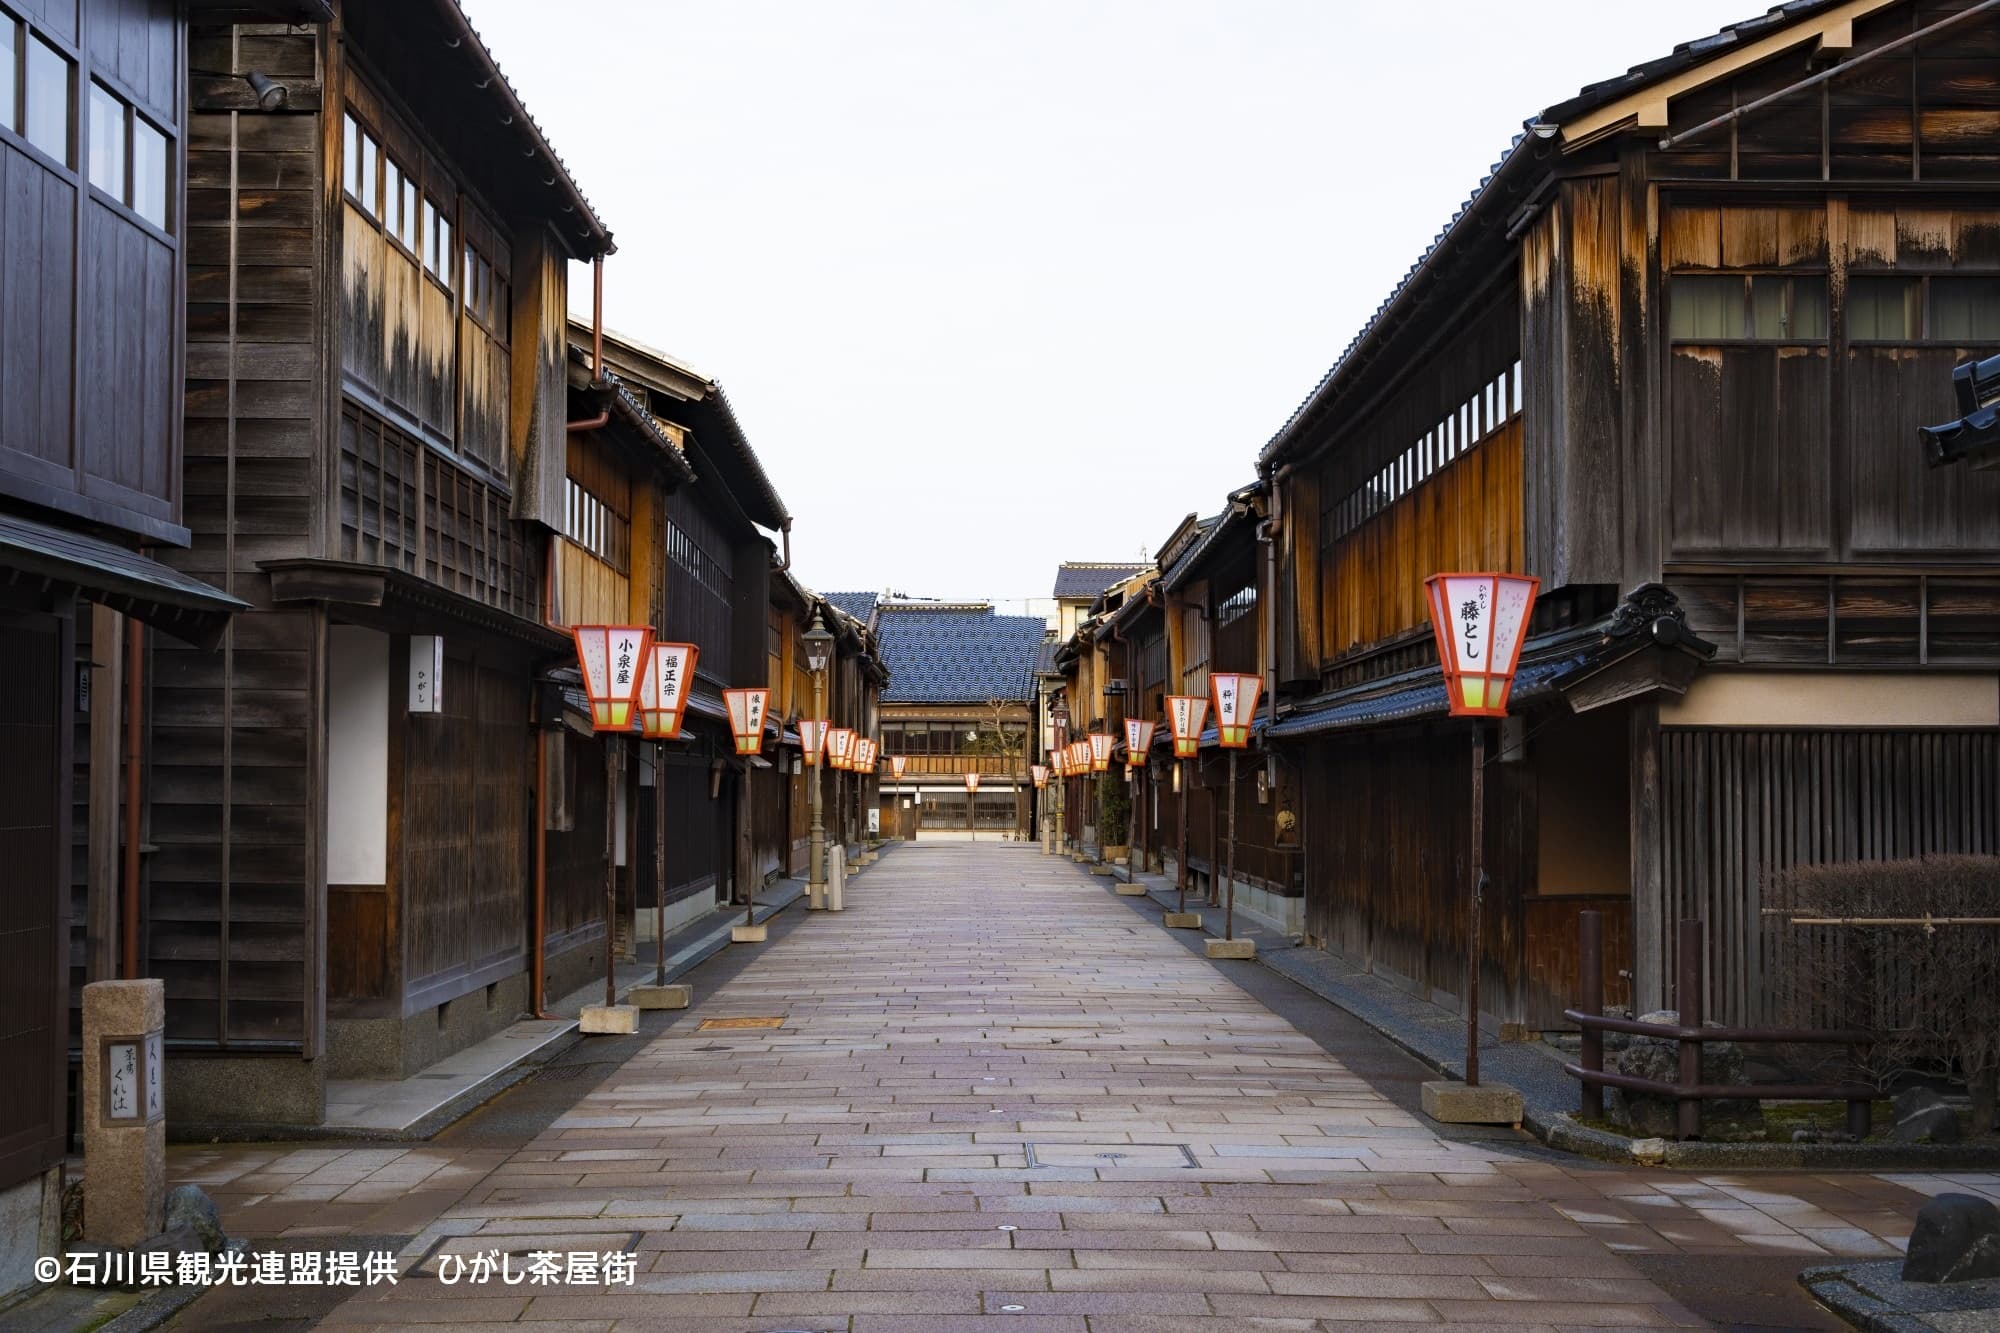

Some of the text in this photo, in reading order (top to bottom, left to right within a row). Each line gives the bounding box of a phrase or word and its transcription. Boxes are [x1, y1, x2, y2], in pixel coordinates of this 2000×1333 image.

[1478, 584, 1487, 610] ひがし
[1460, 599, 1481, 659] 藤とし
[616, 638, 633, 684] 小泉屋
[663, 655, 678, 697] 福正宗
[417, 671, 427, 703] ひがし
[113, 1068, 128, 1112] くれは
